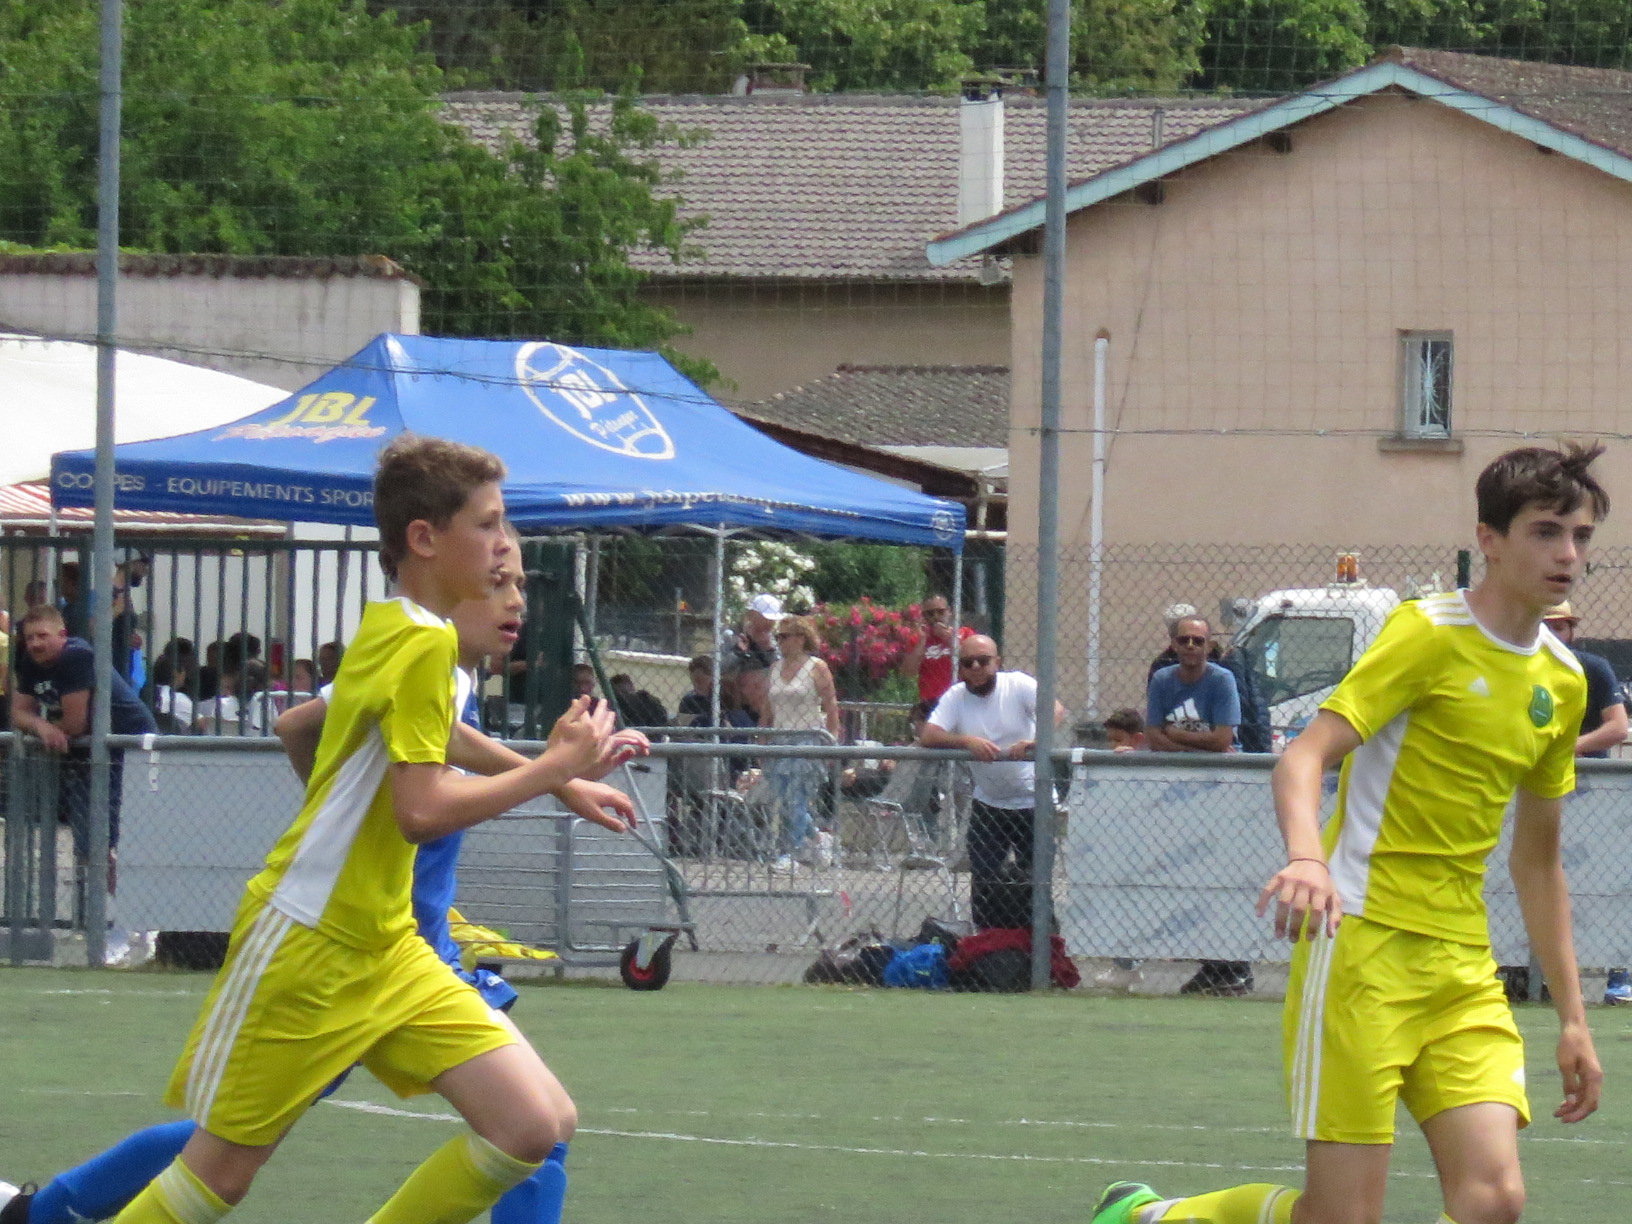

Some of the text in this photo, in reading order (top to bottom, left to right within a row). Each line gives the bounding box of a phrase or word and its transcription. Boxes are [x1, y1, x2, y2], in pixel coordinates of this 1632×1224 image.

[272, 391, 377, 428] JBL
[57, 471, 146, 492] COPES
[167, 476, 315, 504] EQUIPEMENTS
[320, 488, 375, 507] SPOR
